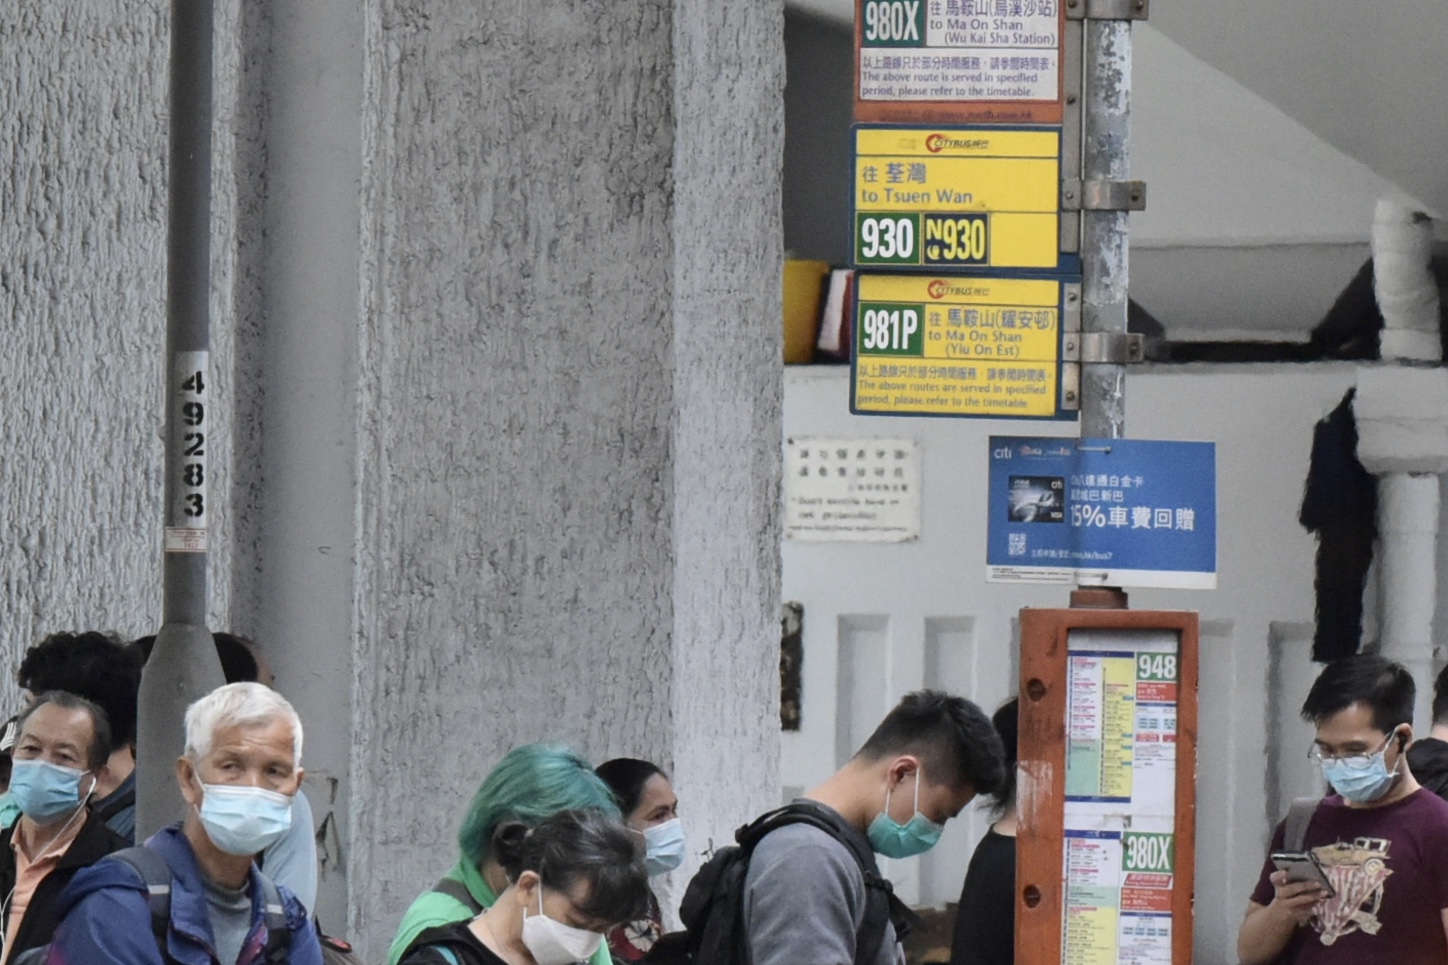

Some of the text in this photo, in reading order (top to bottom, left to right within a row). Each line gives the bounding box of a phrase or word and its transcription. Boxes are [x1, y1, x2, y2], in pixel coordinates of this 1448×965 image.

[866, 1, 919, 40] 980X
[930, 19, 1023, 30] to Ma On Shan
[944, 32, 1056, 45] (Wu Kai Sha Station)
[862, 73, 1038, 84] The above route is served in specified
[862, 86, 1034, 97] period, please refer to the timetable.
[935, 139, 971, 148] CITYBUS
[862, 162, 927, 184] 往 荃灣
[862, 188, 973, 204] to Tsuen Wan
[862, 218, 914, 258] 930
[926, 219, 985, 260] N930
[929, 312, 941, 328] 往
[864, 309, 918, 350] 981P
[929, 330, 1022, 342] to Ma On Shan
[946, 344, 1020, 357] (Yiu On Est)
[859, 380, 1047, 396] The above routes are served in specified
[894, 395, 924, 407] please
[926, 396, 948, 406] refer
[952, 397, 963, 406] to
[966, 397, 980, 407] the
[182, 371, 205, 517] 49283
[1139, 654, 1177, 679] 948
[1126, 836, 1171, 870] 980X
